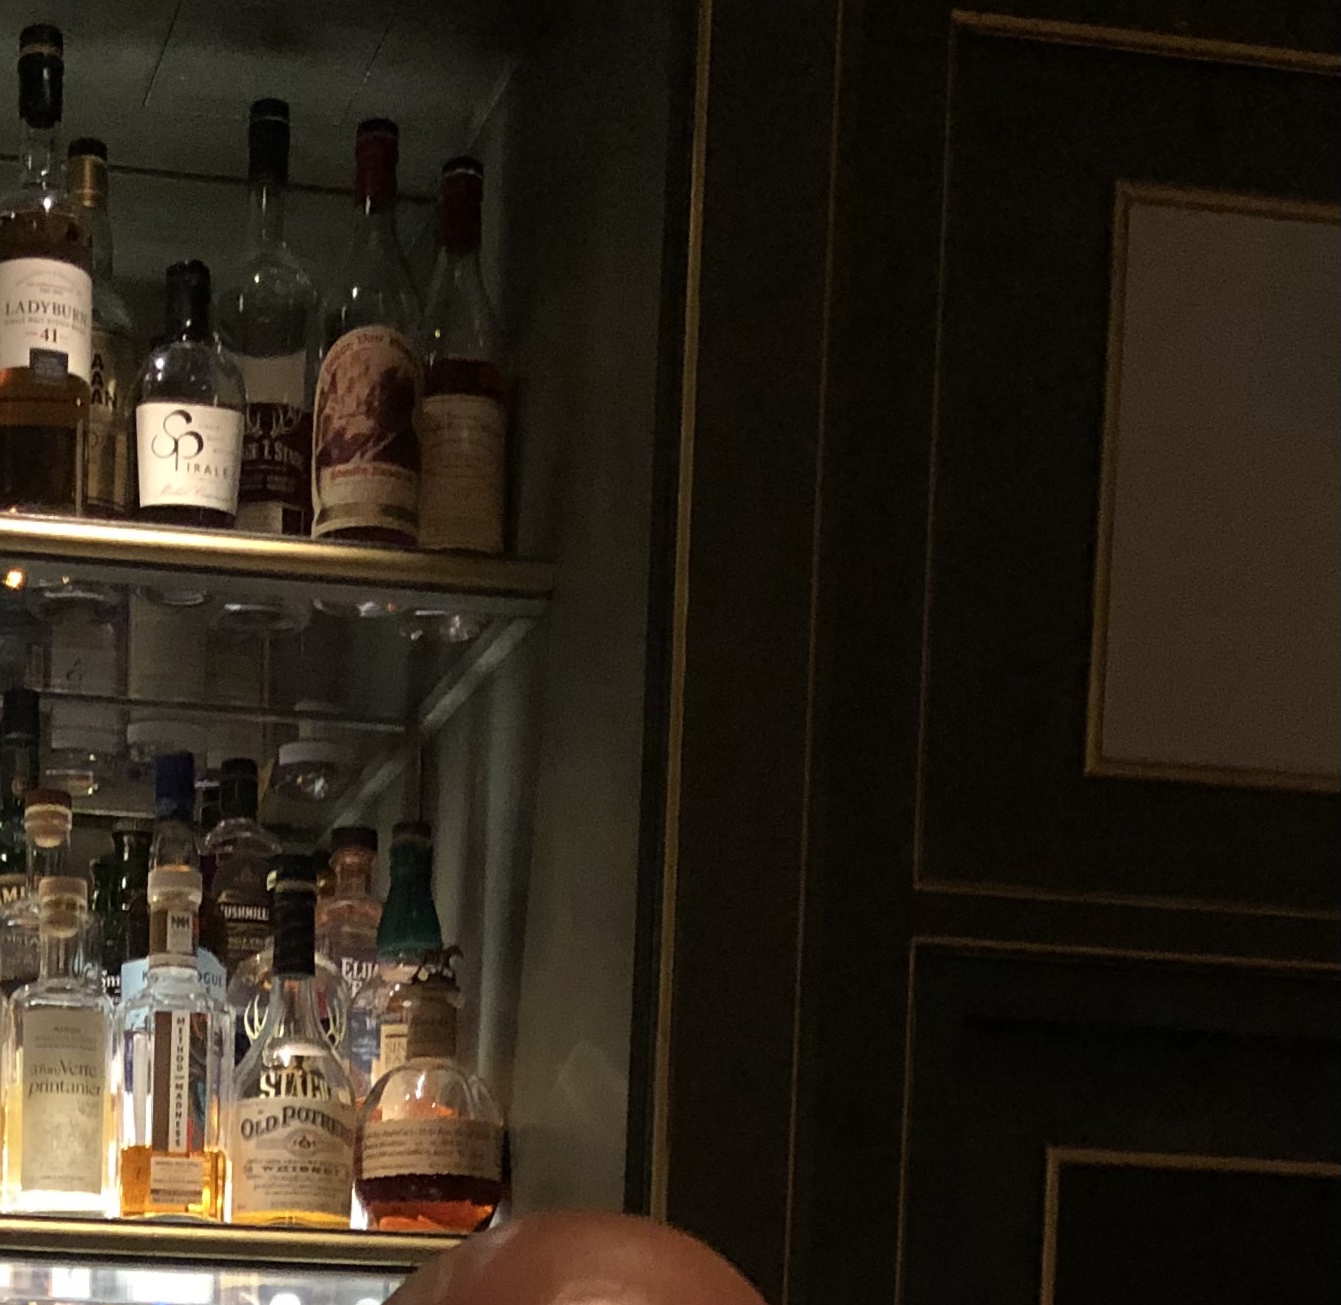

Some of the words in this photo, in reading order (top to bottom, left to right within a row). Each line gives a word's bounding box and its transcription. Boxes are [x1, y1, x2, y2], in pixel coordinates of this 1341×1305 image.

[4, 300, 89, 325] LADYBURN
[40, 327, 58, 343] 41
[222, 904, 270, 921] USHMILL
[175, 1017, 186, 1073] METHOD
[28, 1080, 101, 1098] printanier
[174, 1083, 185, 1148] MADNESS
[241, 1115, 278, 1141] OLD
